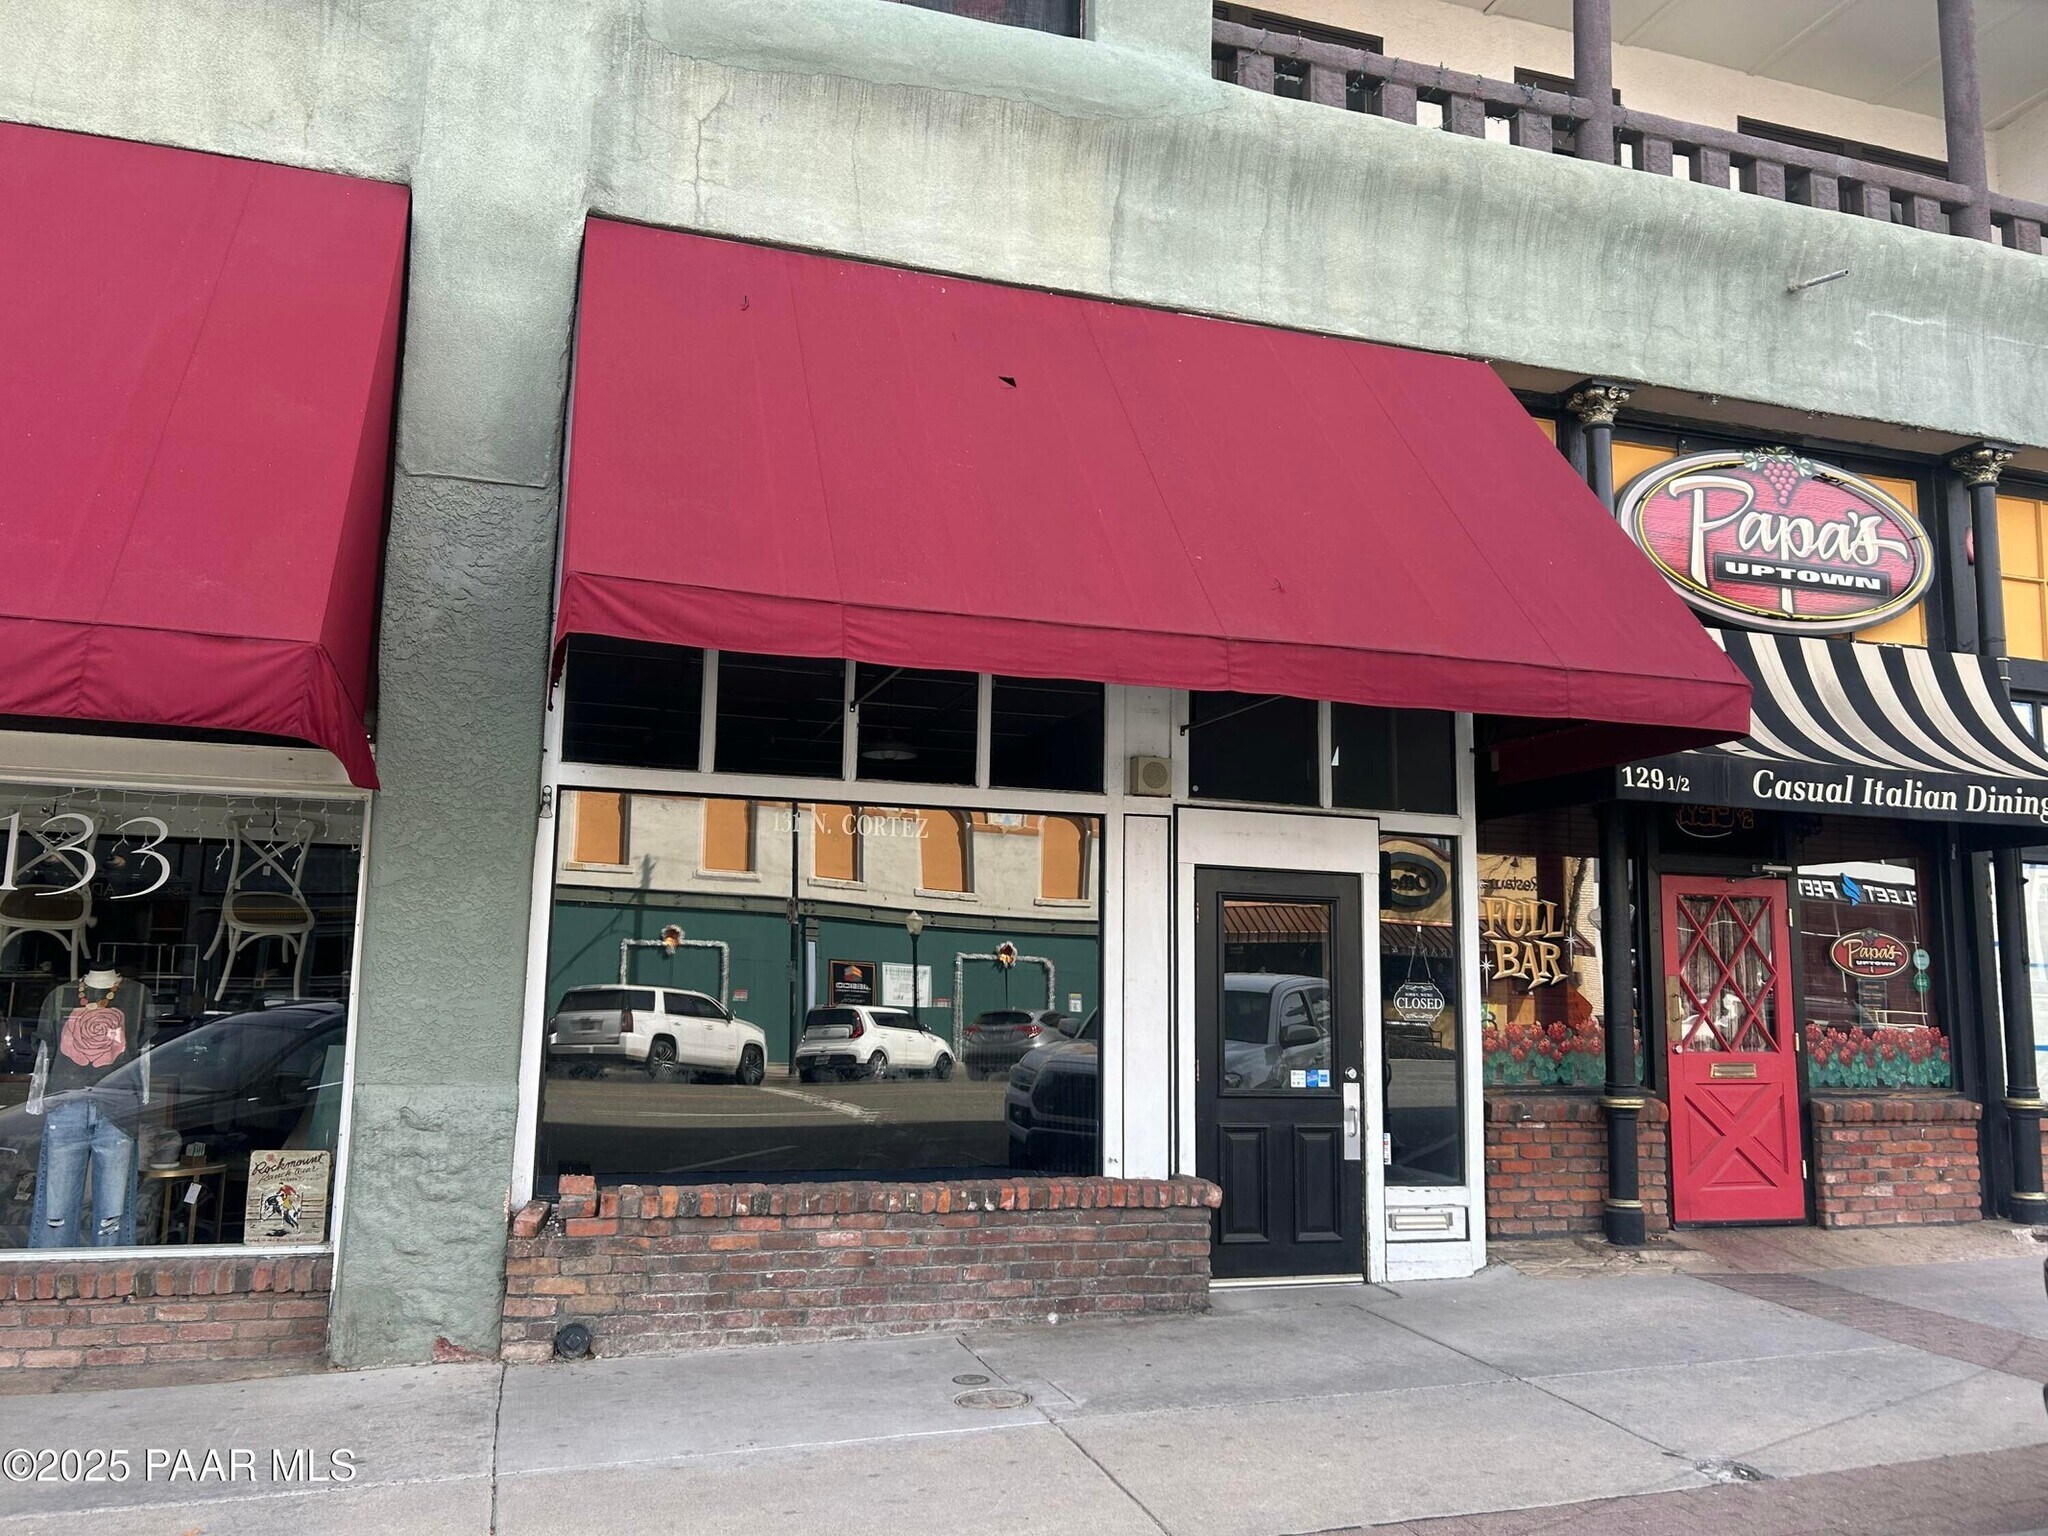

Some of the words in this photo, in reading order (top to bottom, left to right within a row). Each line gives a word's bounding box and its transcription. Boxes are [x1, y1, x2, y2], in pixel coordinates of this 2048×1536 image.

[1668, 475, 1908, 614] Papa's
[1725, 561, 1881, 590] UPTOWN
[1621, 766, 1665, 790] 129
[1667, 774, 1690, 793] 1/2
[1753, 769, 1853, 805] Casual
[1863, 778, 1957, 811] Italian
[773, 810, 800, 833] 131
[813, 813, 831, 834] N.
[841, 814, 929, 839] CORTEZ
[0, 812, 171, 899] 133
[1481, 896, 1565, 938] FULL
[1489, 939, 1569, 990] BAR
[1842, 938, 1903, 974] Papa's
[1396, 997, 1443, 1010] CLOSED
[252, 1152, 328, 1176] Rockmount
[258, 1168, 292, 1183] Ranch
